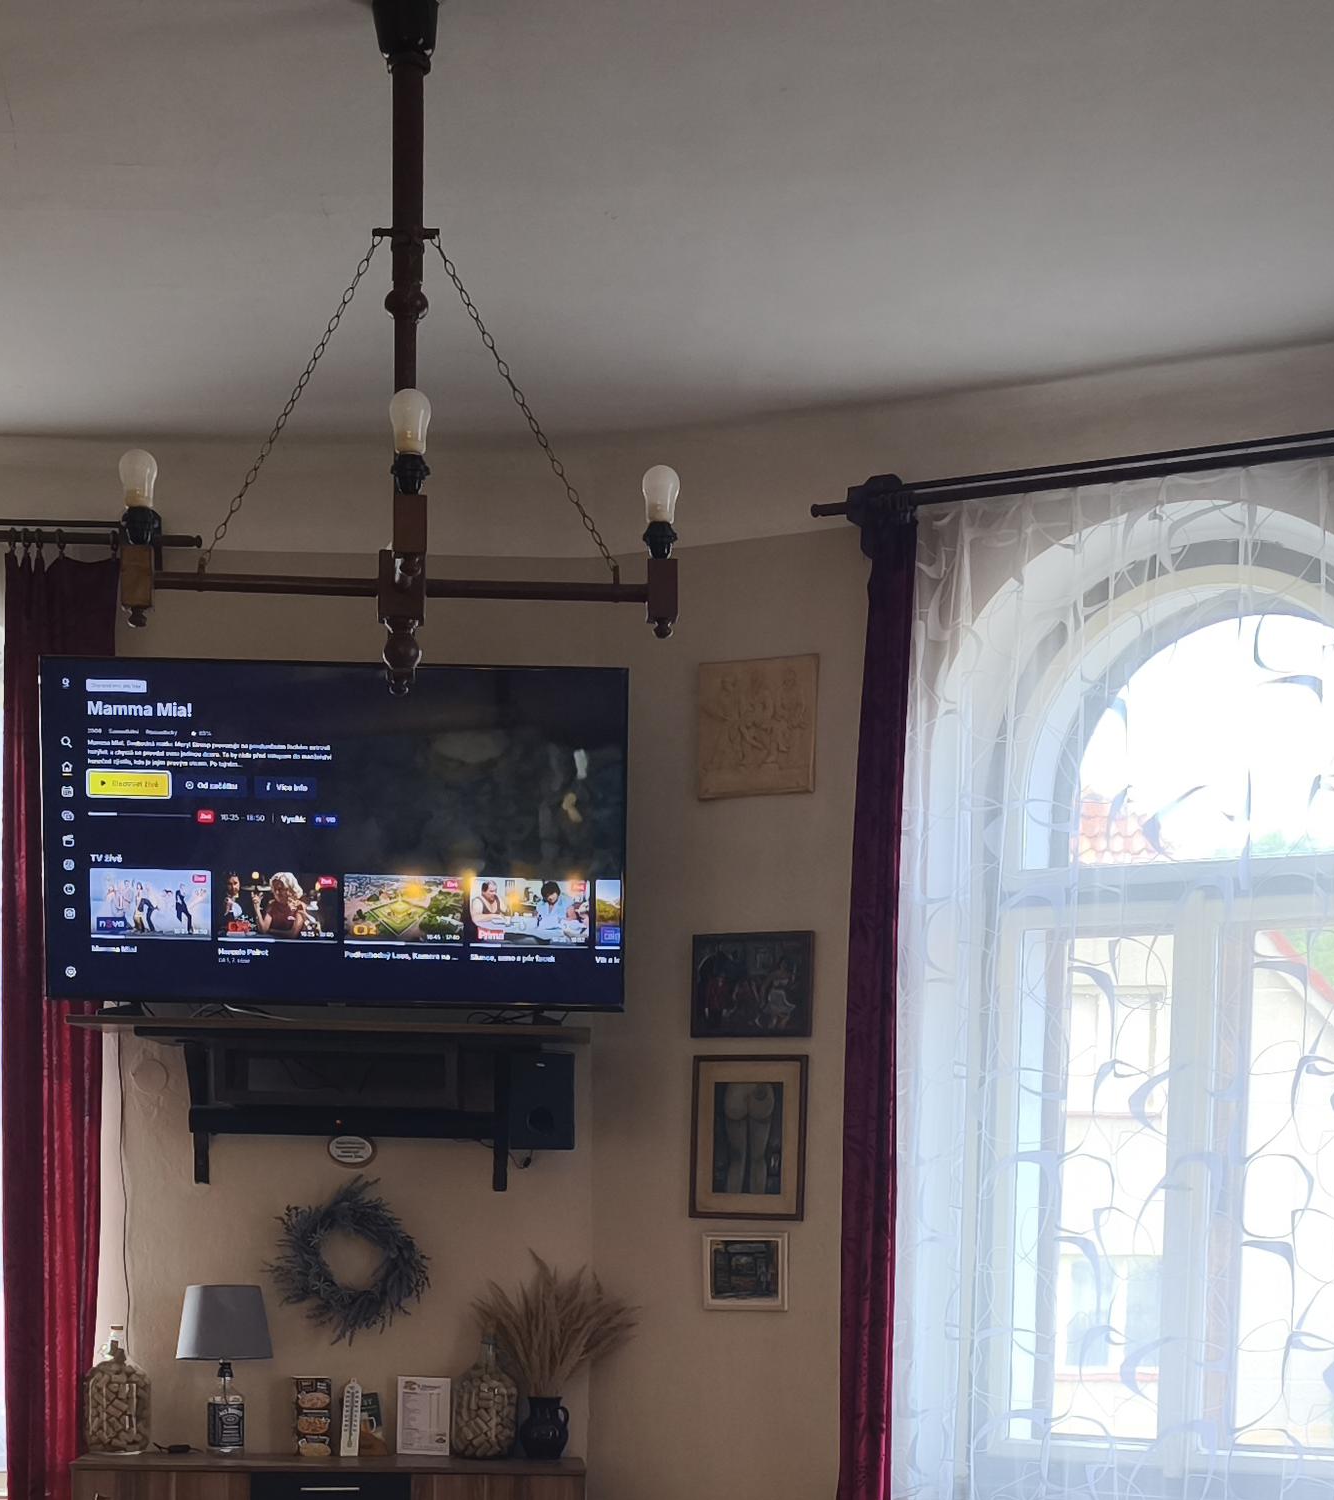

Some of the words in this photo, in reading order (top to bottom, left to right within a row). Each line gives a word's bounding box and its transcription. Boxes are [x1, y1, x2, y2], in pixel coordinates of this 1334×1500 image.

[87, 700, 153, 717] Mamma
[156, 701, 193, 718] Mia!
[89, 854, 103, 863] TV
